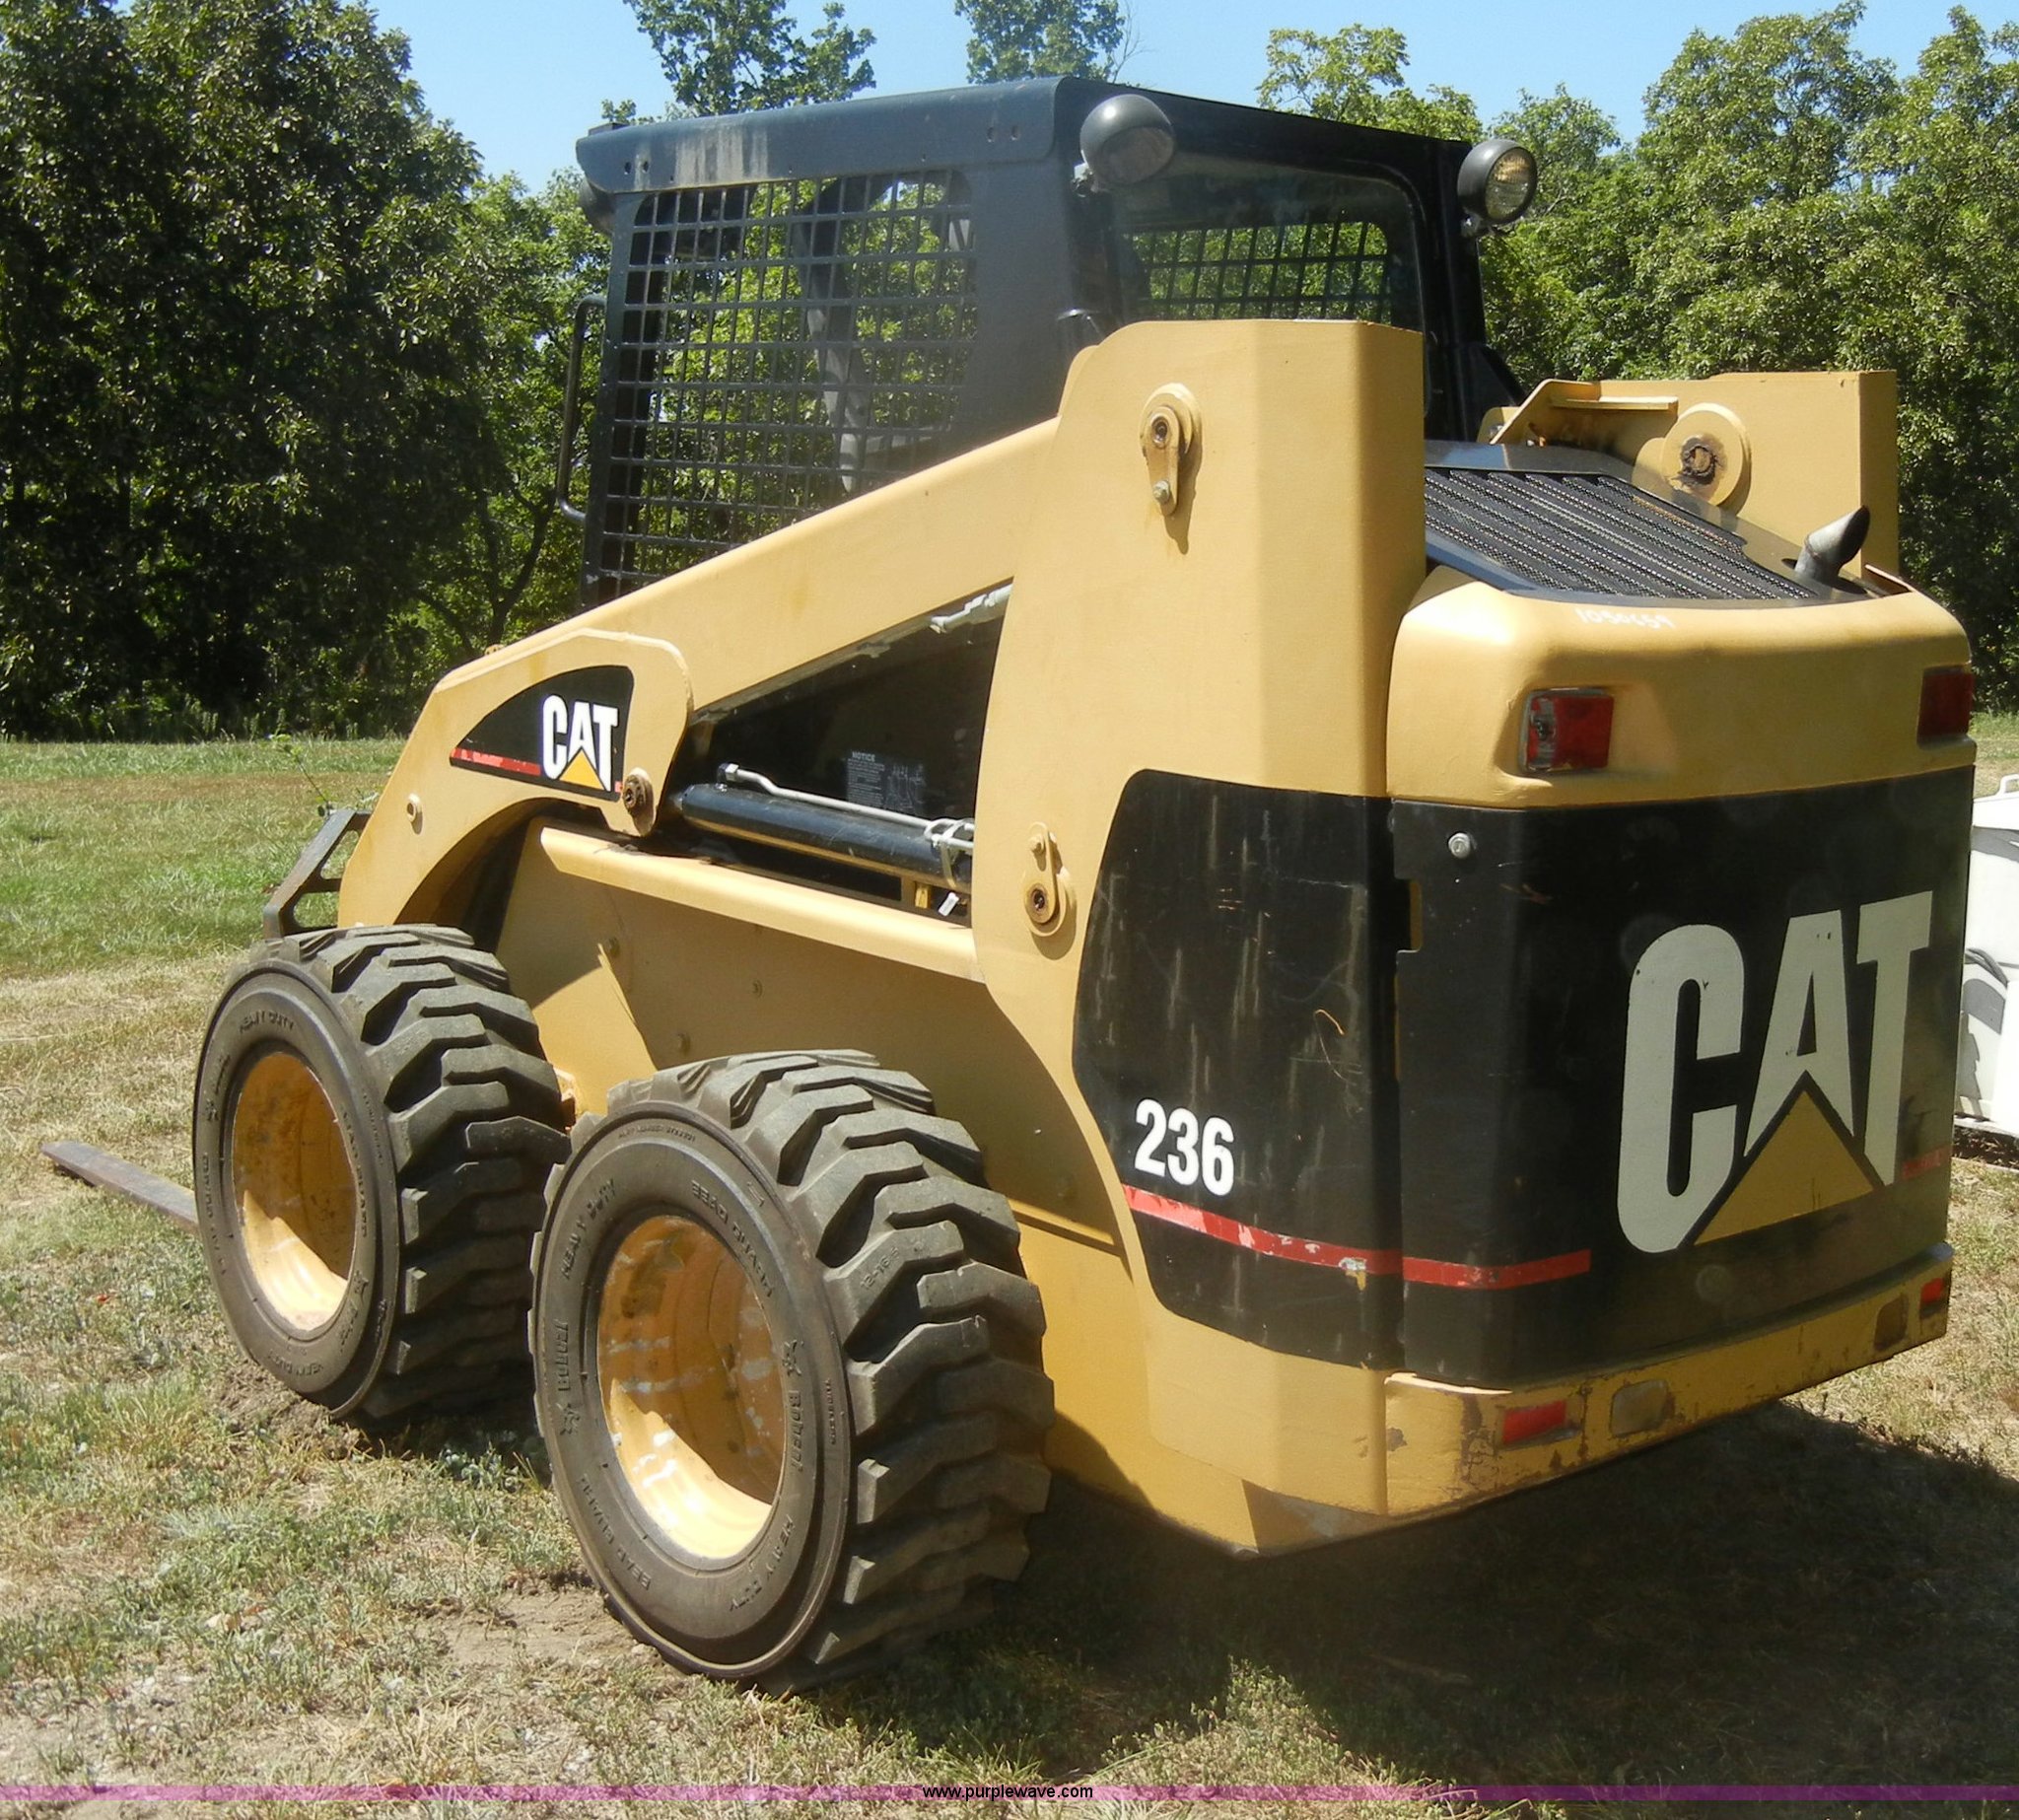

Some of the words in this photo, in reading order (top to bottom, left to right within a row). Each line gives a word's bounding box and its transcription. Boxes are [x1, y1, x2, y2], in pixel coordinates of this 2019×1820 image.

[543, 694, 619, 792] CAT
[851, 750, 876, 763] NOTICE
[1617, 890, 1933, 1253] CAT
[1134, 1098, 1235, 1197] 236
